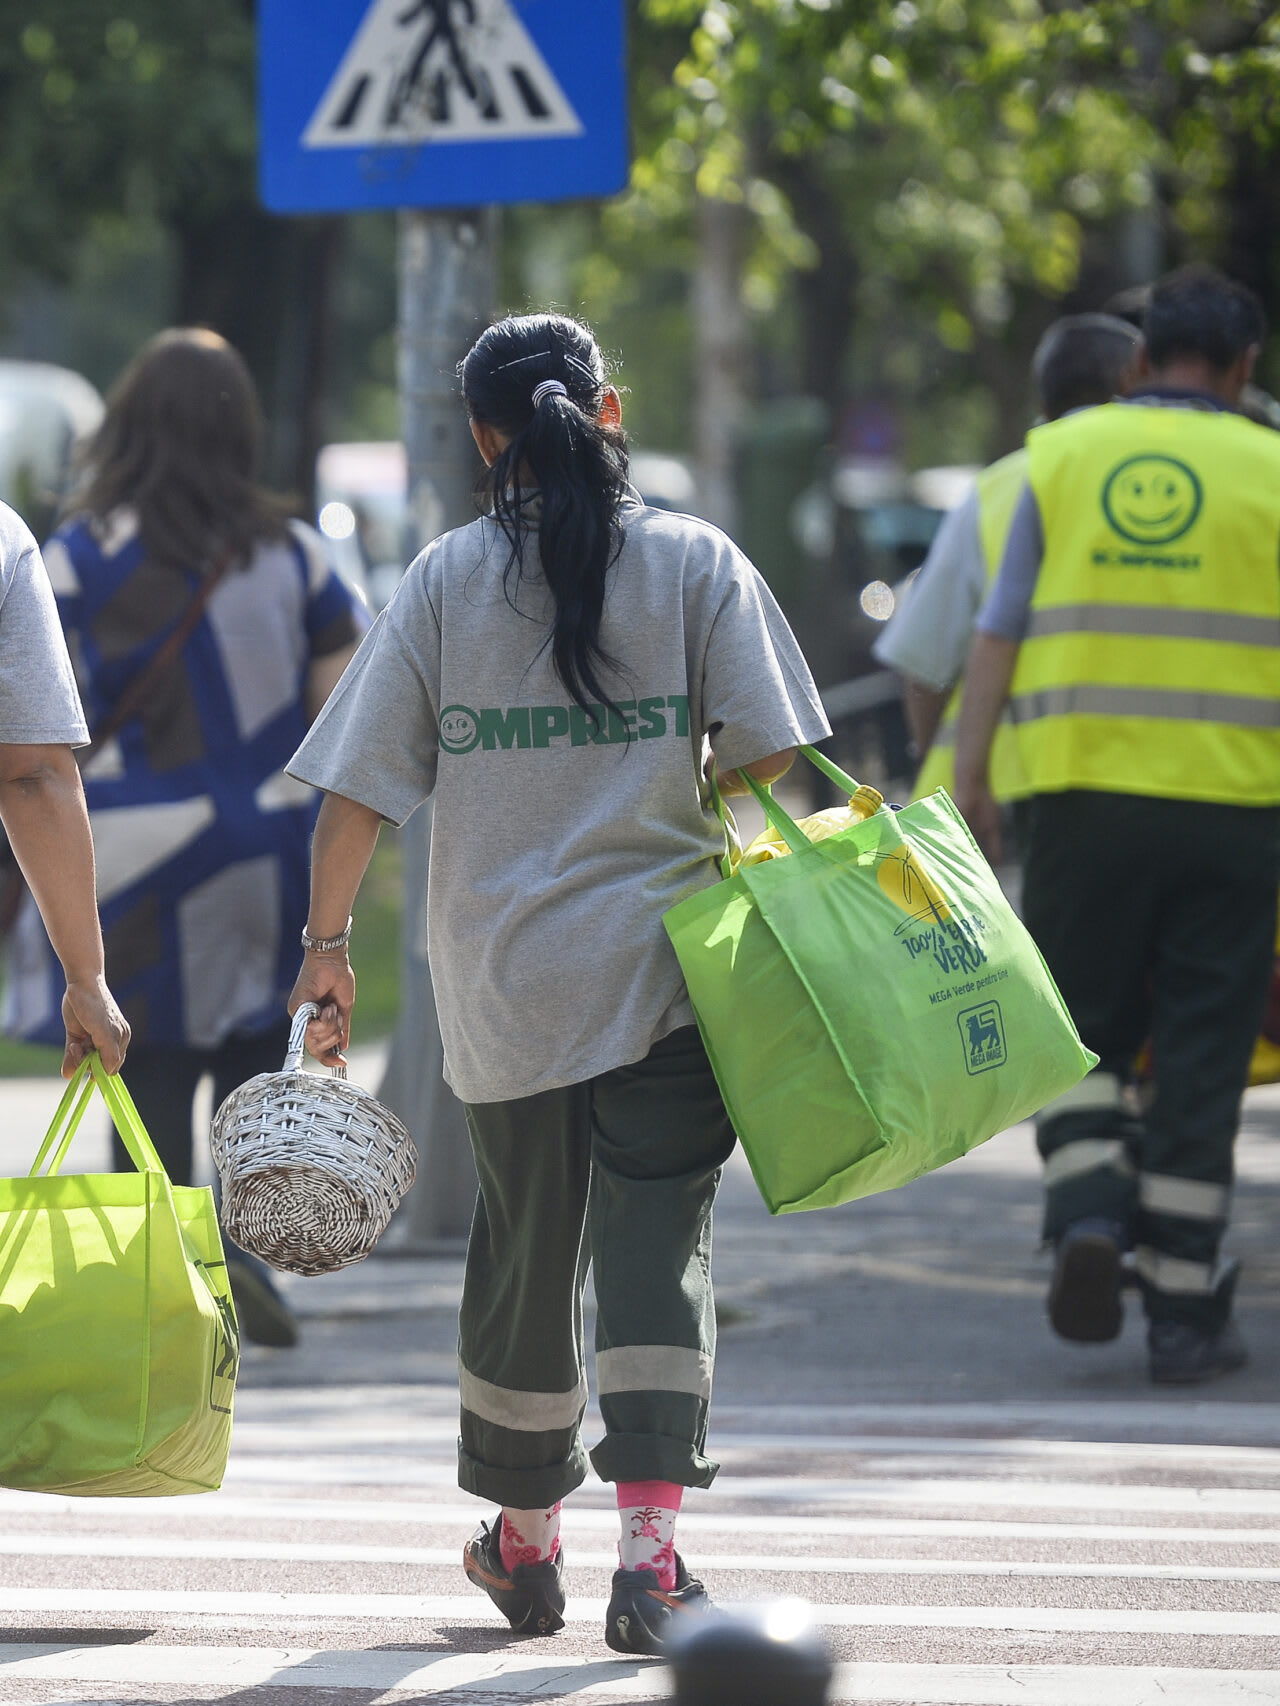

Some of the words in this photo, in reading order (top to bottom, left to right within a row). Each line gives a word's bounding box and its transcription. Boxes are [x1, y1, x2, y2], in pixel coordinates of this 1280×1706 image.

[901, 928, 946, 960] 100%
[928, 989, 952, 1005] MEGA
[952, 981, 975, 996] Verde
